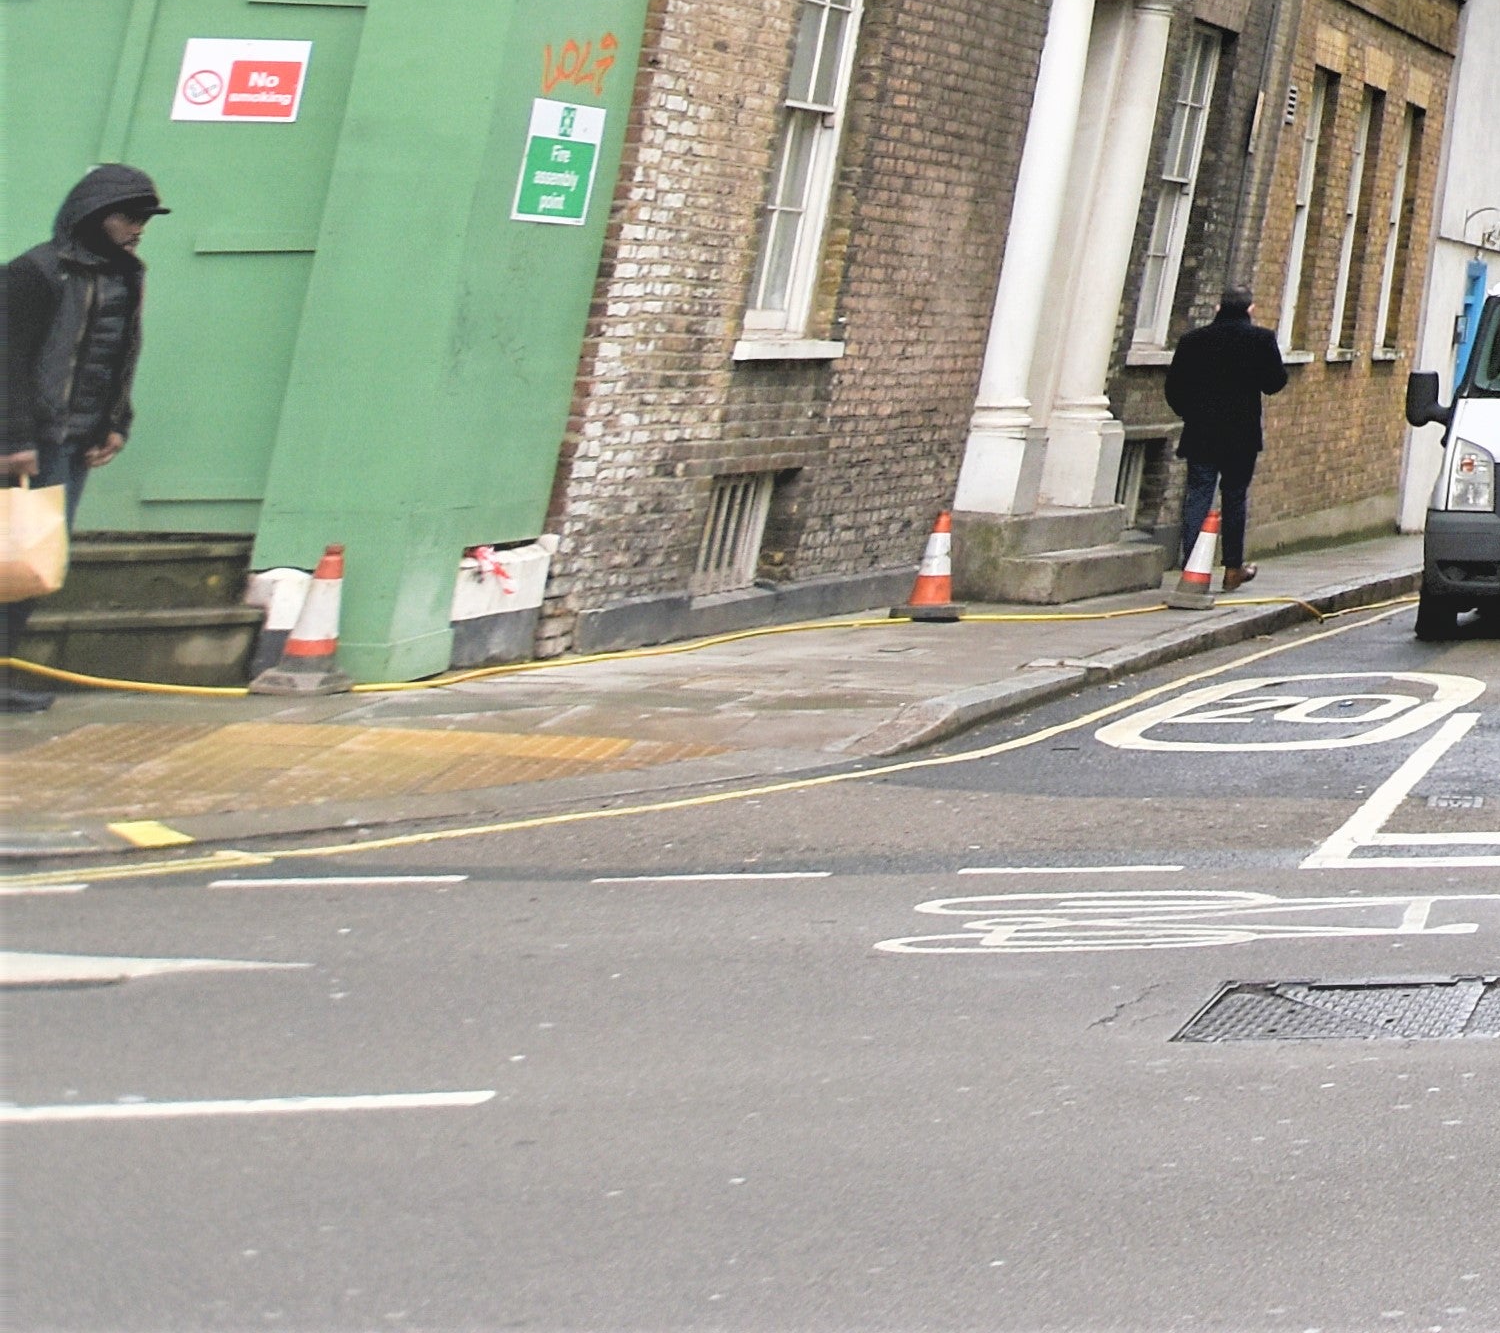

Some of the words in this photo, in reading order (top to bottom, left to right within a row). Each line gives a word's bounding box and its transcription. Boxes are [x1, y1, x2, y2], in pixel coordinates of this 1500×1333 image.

[248, 71, 280, 88] No
[228, 91, 293, 106] smoking
[551, 144, 572, 163] Fire
[533, 170, 580, 192] assembly
[537, 192, 566, 213] point
[1162, 693, 1421, 724] 20
